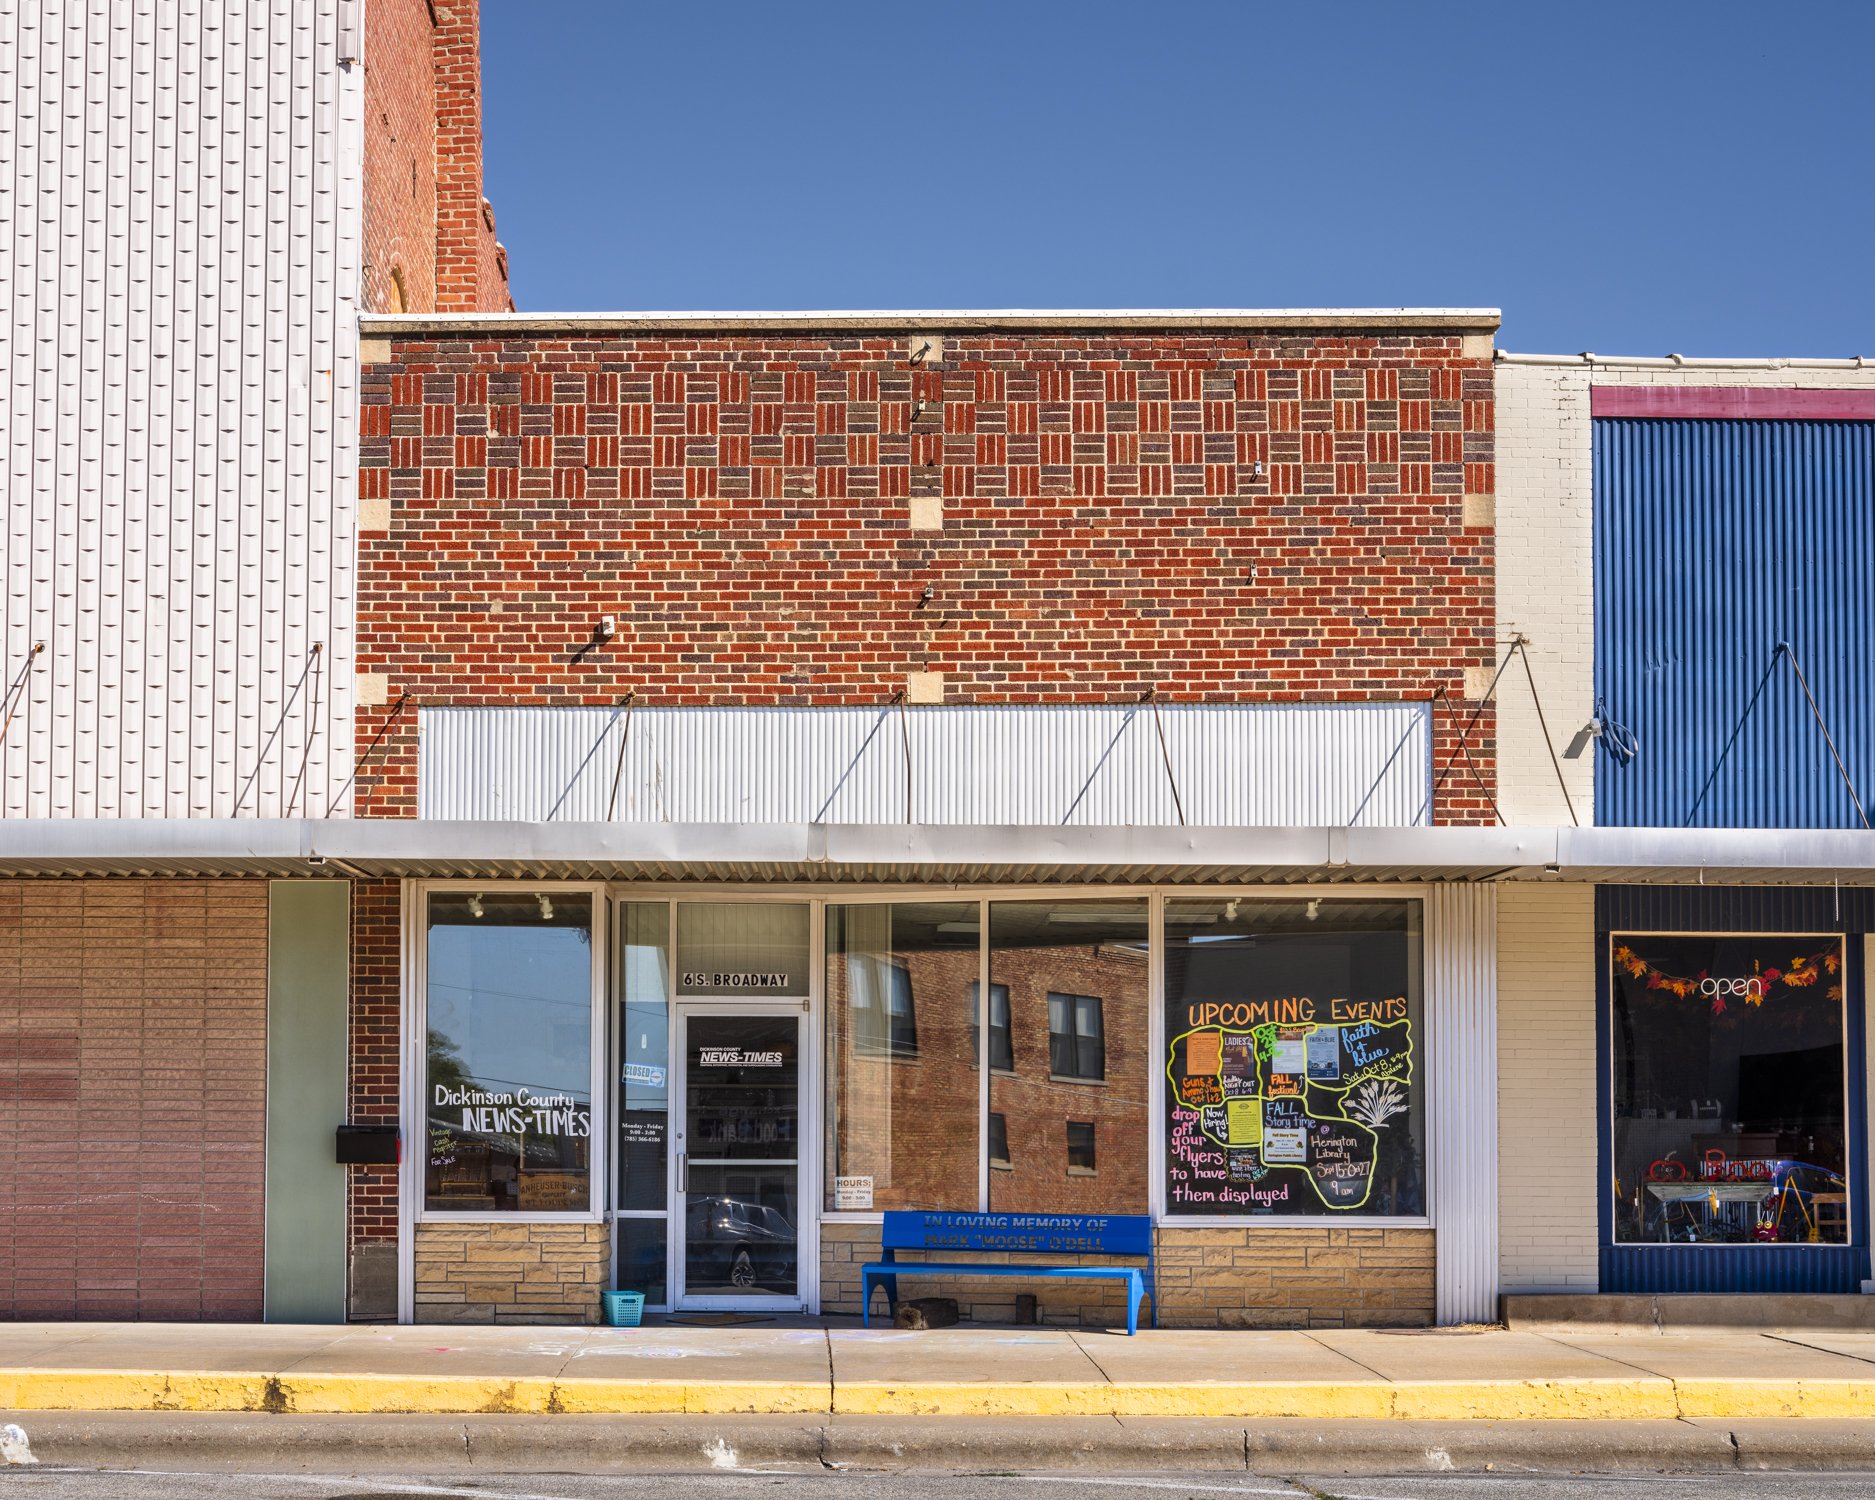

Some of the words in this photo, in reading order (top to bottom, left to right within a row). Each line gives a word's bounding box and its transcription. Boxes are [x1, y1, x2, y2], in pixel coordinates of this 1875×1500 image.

[684, 973, 692, 985] 6
[696, 973, 709, 985] S.
[713, 974, 786, 986] BROADWAY
[1701, 978, 1761, 1000] open
[1189, 997, 1316, 1026] UPCOMING
[1331, 997, 1407, 1020] EVENTS
[1255, 1024, 1277, 1039] Oct
[1341, 1022, 1380, 1054] faith
[1260, 1034, 1276, 1049] 29
[700, 1051, 783, 1062] NEWS-TIMES
[1352, 1047, 1390, 1067] blue
[624, 1065, 651, 1078] CLOSED
[1363, 1063, 1381, 1079] Oct
[1183, 1077, 1206, 1088] Guns
[1271, 1073, 1293, 1086] FALL
[435, 1084, 512, 1106] Dickinson
[517, 1088, 575, 1113] County
[1267, 1081, 1300, 1100] festival
[1171, 1105, 1200, 1123] drop
[1266, 1102, 1298, 1115] FALL
[462, 1107, 591, 1137] NEWS-TIMES
[622, 1122, 643, 1130] Monday
[1173, 1121, 1194, 1137] off
[1203, 1114, 1229, 1129] Hiring!
[1265, 1115, 1291, 1128] Story
[1294, 1113, 1316, 1129] time
[1320, 1125, 1330, 1134] @
[1171, 1136, 1206, 1154] your
[1310, 1135, 1357, 1152] Herington
[1180, 1145, 1224, 1168] flyers
[1316, 1148, 1351, 1165] Library
[1170, 1167, 1188, 1180] to
[1194, 1168, 1227, 1180] have
[1172, 1182, 1215, 1202] them
[1219, 1183, 1289, 1207] displayed
[1331, 1181, 1339, 1195] 9
[1341, 1187, 1354, 1196] am
[924, 1215, 942, 1227] IN
[947, 1215, 1008, 1228] LOVING
[1012, 1217, 1083, 1231] MEMORY
[1086, 1219, 1108, 1232] OF
[924, 1234, 970, 1248] MARK
[975, 1235, 1045, 1249] "MOOSE"
[1050, 1236, 1104, 1251] O'DELL
